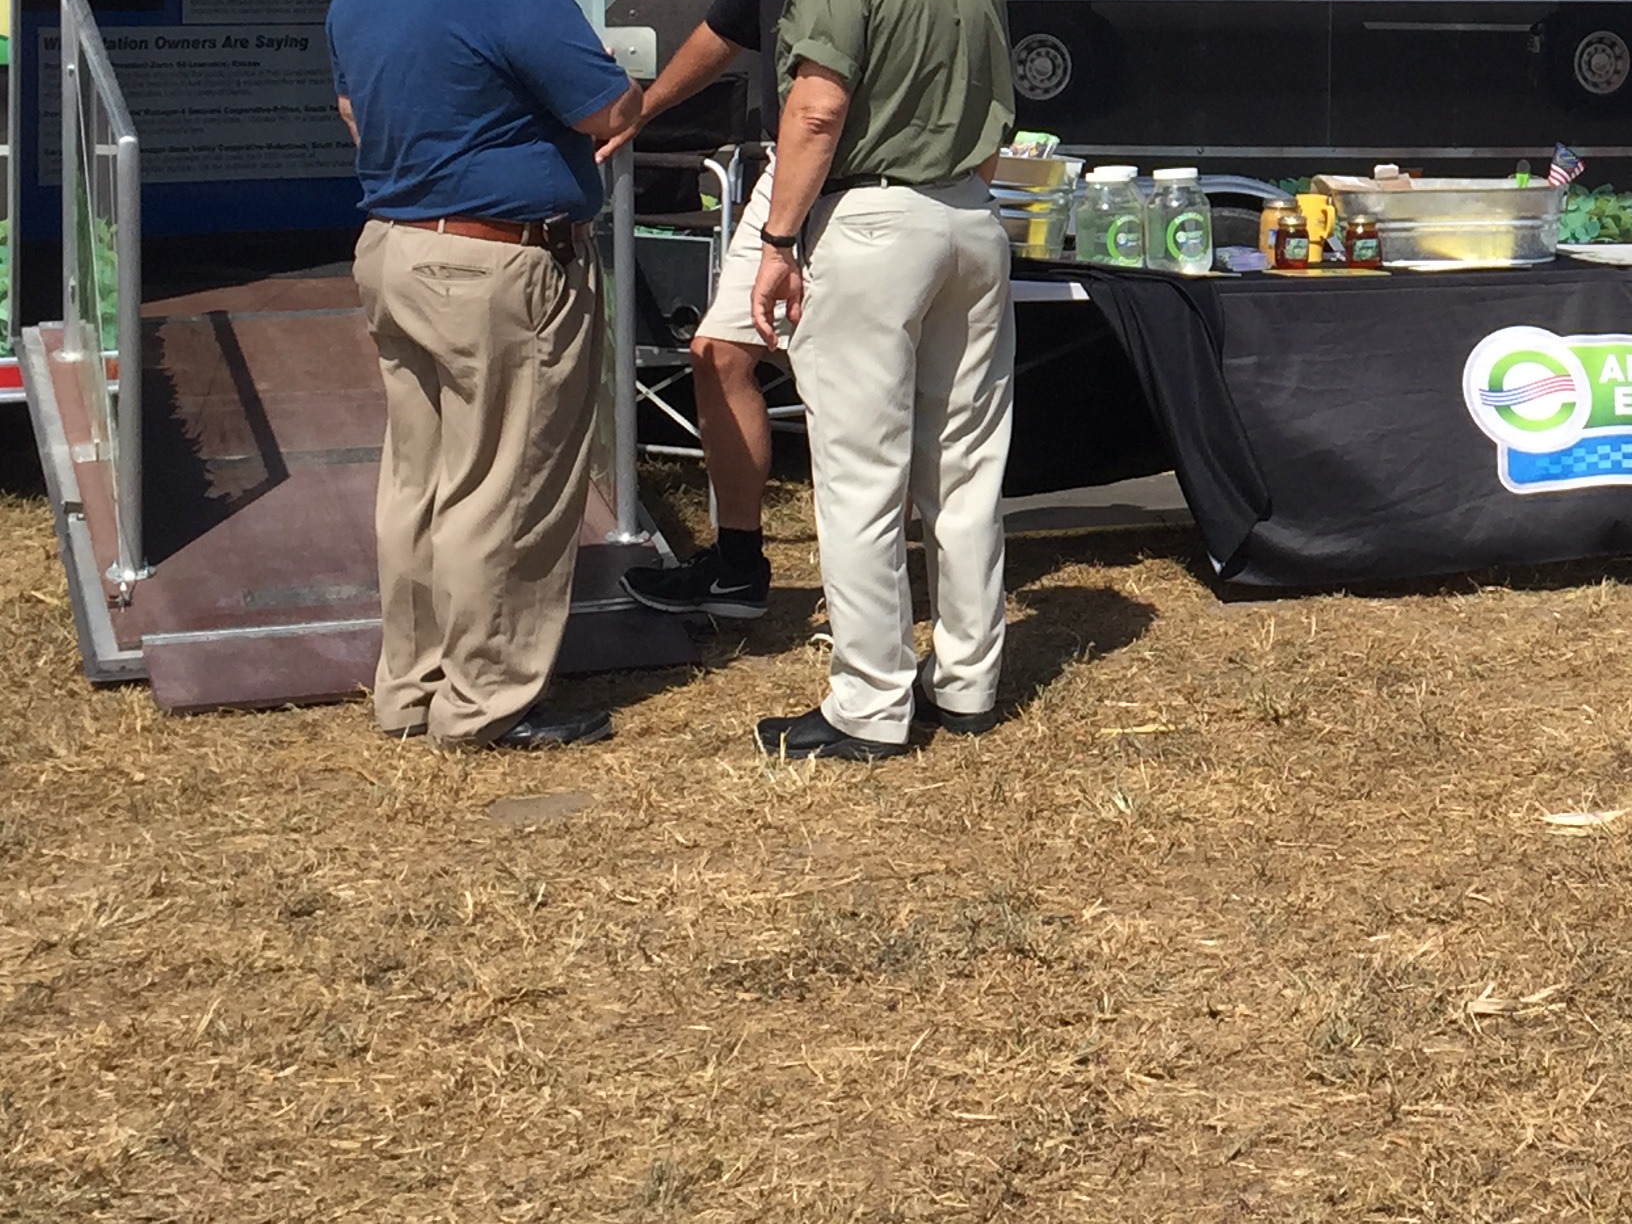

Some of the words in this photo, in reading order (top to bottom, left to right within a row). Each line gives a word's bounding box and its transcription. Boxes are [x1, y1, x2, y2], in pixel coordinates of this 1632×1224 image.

[154, 36, 217, 50] Owners
[222, 35, 249, 49] Are
[255, 34, 310, 52] Saying
